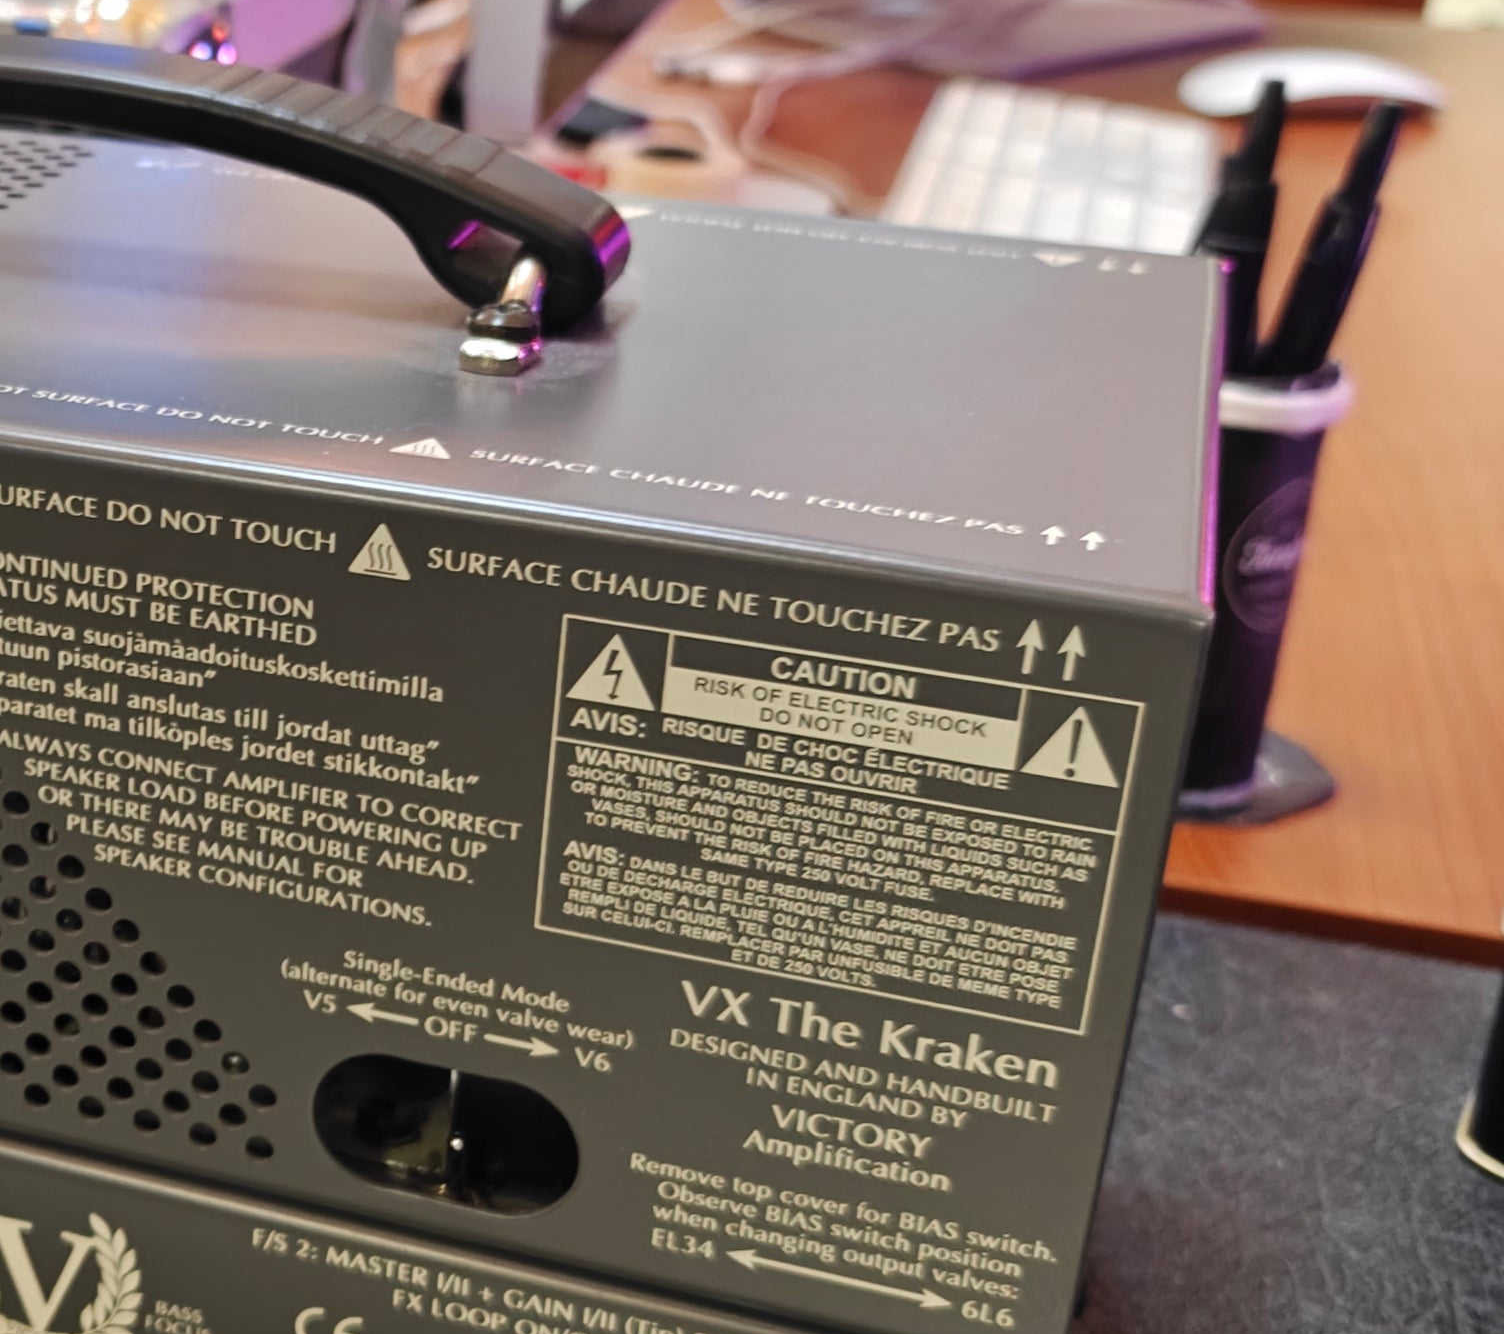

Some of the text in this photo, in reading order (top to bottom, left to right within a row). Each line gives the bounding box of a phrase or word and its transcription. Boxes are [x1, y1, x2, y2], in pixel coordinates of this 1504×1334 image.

[32, 389, 149, 414] SURFACE
[156, 406, 203, 420] DO
[208, 414, 271, 430] NOT
[282, 424, 384, 446] TOUCH
[106, 500, 152, 526] DO
[160, 508, 223, 536] NOT
[230, 518, 336, 554] TOUCH
[65, 588, 142, 618] MUST
[149, 601, 181, 625] BE
[189, 607, 318, 646] EARTHED
[136, 572, 314, 620] PROTECTION
[427, 547, 1000, 652] SURFACE CHAUDE NE TOUCHEZ PAS
[694, 676, 986, 737] RISK OF ELECTRIC SHOCK
[771, 656, 917, 700] CAUTION
[570, 707, 1011, 790] AVIS: RISQUE DE CHOC ÉLECTRIQUE
[759, 706, 913, 746] DO NOT OPEN
[97, 747, 217, 784] CONNECT
[222, 770, 349, 810] AMPLIFIER
[356, 793, 394, 817] TO
[400, 803, 523, 841] CORRECT
[574, 745, 1093, 851] WARNING: TO REDUCE THE RISK OF FIRE OR ELECTRIC
[745, 751, 918, 795] NE PAS OUVRIR
[24, 757, 488, 859] SPEAKER LOAD BEFORE POWERING UP
[37, 784, 474, 884] OR THERE MAY BE TROUBLE AHEAD.
[66, 813, 363, 888] PLEASE SEE MANUAL FOR
[94, 843, 432, 927] SPEAKER CONFIGURATIONS.
[281, 960, 634, 1050] (alternate for even valve wear)
[343, 950, 570, 1013] Single-Ended Mode
[303, 989, 611, 1072] V5 OFF V6
[681, 980, 1058, 1089] VX The Kraken
[669, 1028, 1057, 1123] DESIGNED AND HANDBUILT
[746, 1067, 967, 1128] IN ENGLAND BY
[742, 1129, 951, 1192] Amplification
[772, 1104, 932, 1158] VICTORY
[630, 1152, 1057, 1263] Remove top cover for BIAS switch.
[657, 1181, 1023, 1278] Observe BIAS switch position
[252, 1227, 288, 1253] F/S
[296, 1239, 318, 1260] 2:
[325, 1246, 428, 1288] MASTER
[503, 1289, 575, 1322] GAIN
[651, 1227, 715, 1259] EL34
[652, 1205, 1020, 1300] when changing output valves:
[155, 1300, 203, 1325] BASS
[392, 1288, 422, 1313] FX
[431, 1298, 508, 1331] LOOP
[961, 1300, 1015, 1328] 6L6
